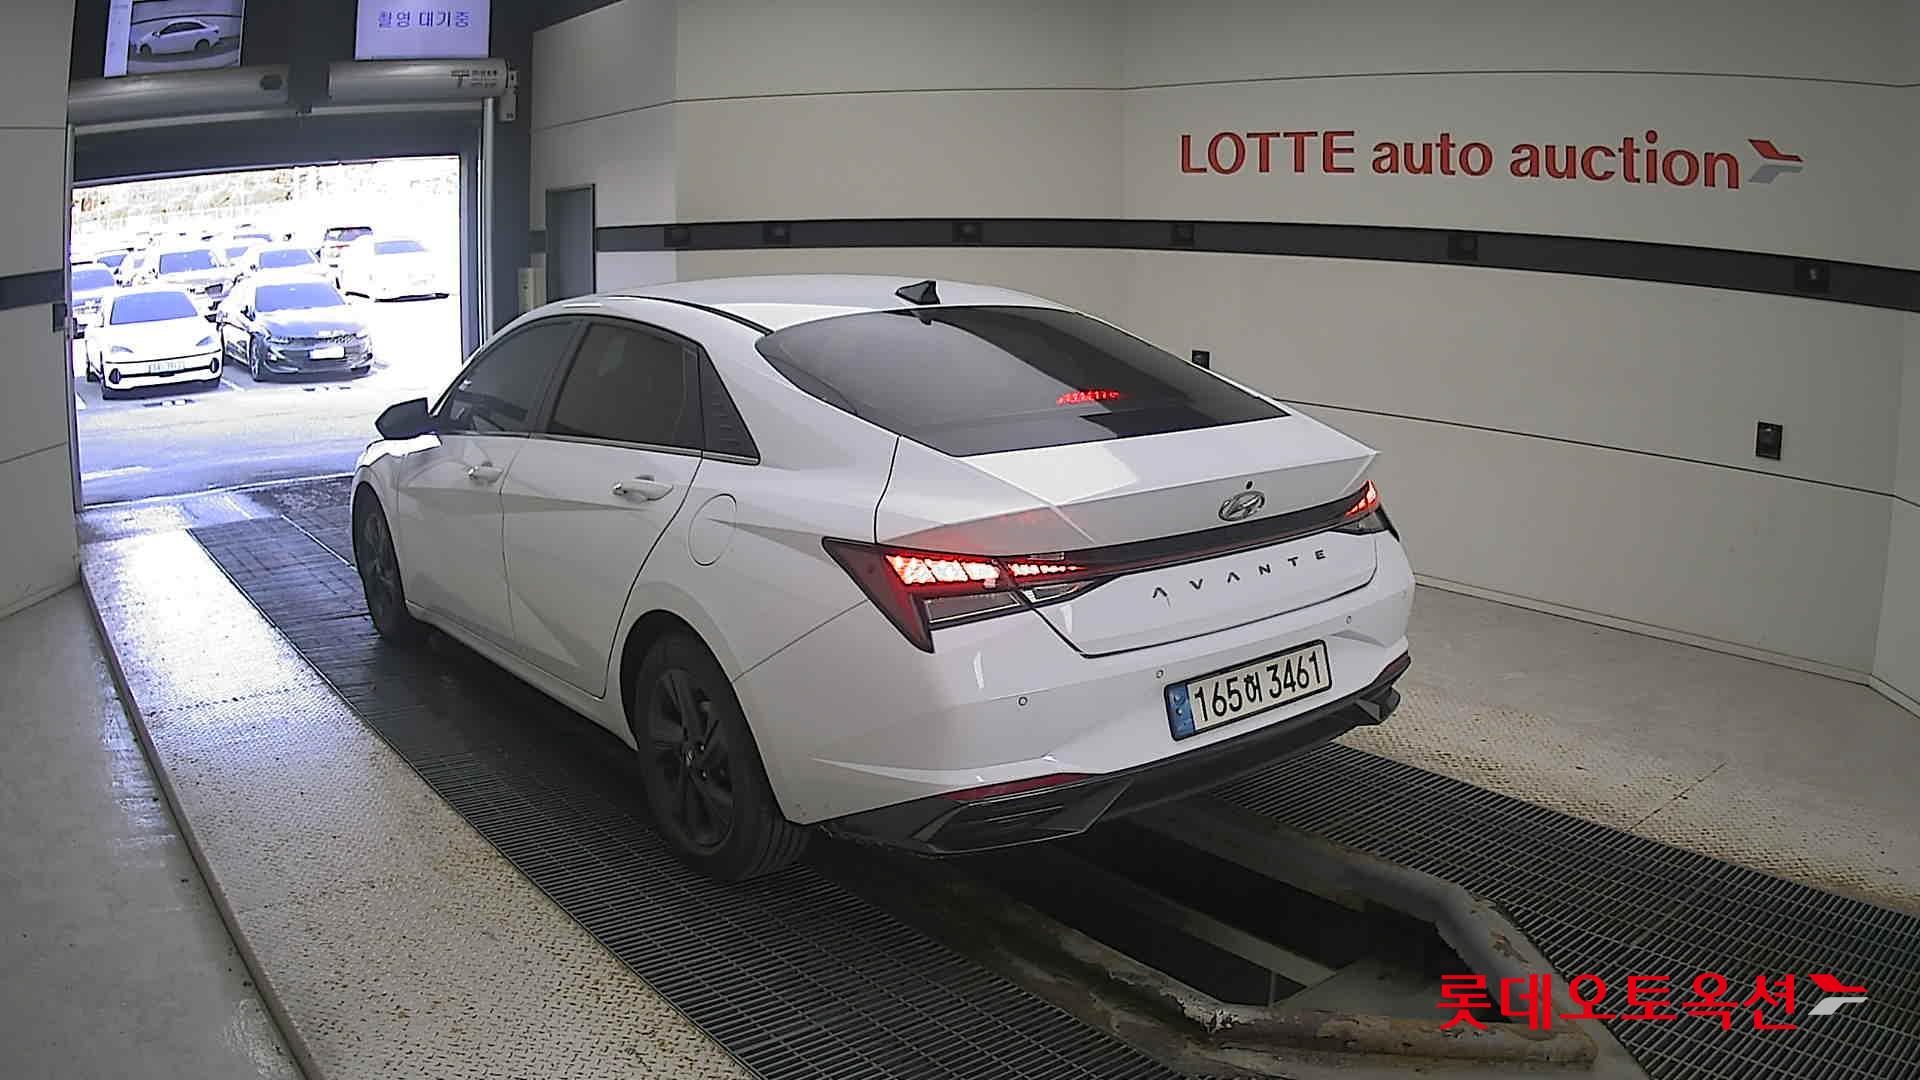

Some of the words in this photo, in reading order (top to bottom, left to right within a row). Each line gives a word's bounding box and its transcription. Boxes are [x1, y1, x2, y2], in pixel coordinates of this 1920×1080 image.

[418, 11, 470, 28] 대기중
[1180, 130, 1356, 175] LOTTE
[1371, 132, 1494, 177] auto
[1509, 129, 1740, 190] auction
[1151, 549, 1327, 599] AVANTE
[1194, 672, 1263, 722] 165허
[1266, 649, 1321, 699] 3461
